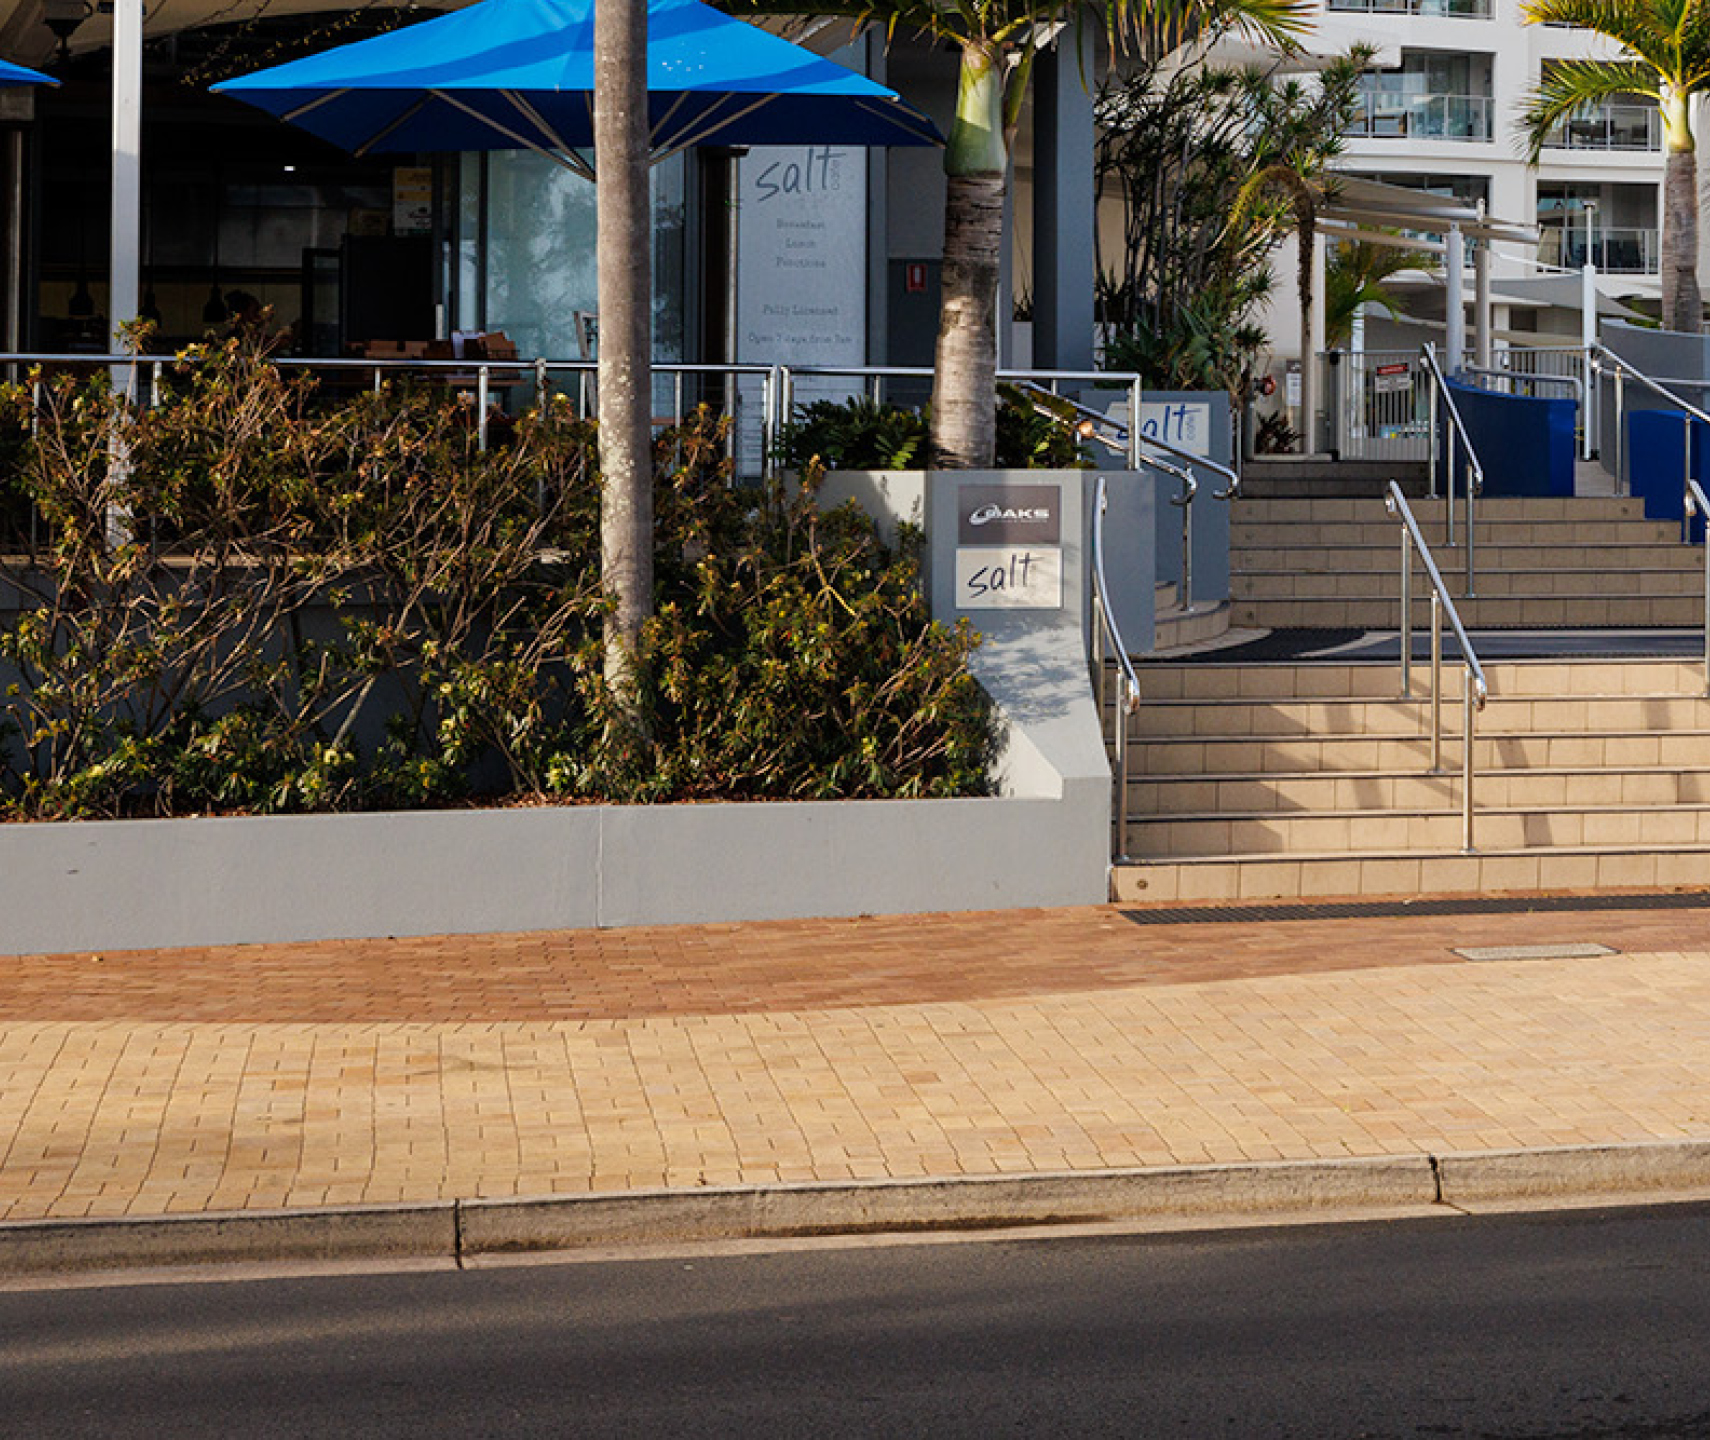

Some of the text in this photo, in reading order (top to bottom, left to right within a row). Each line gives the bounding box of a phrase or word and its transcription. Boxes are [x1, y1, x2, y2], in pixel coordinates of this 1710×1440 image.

[755, 145, 846, 202] salt
[968, 503, 1050, 526] OAKS
[966, 552, 1046, 599] salt
